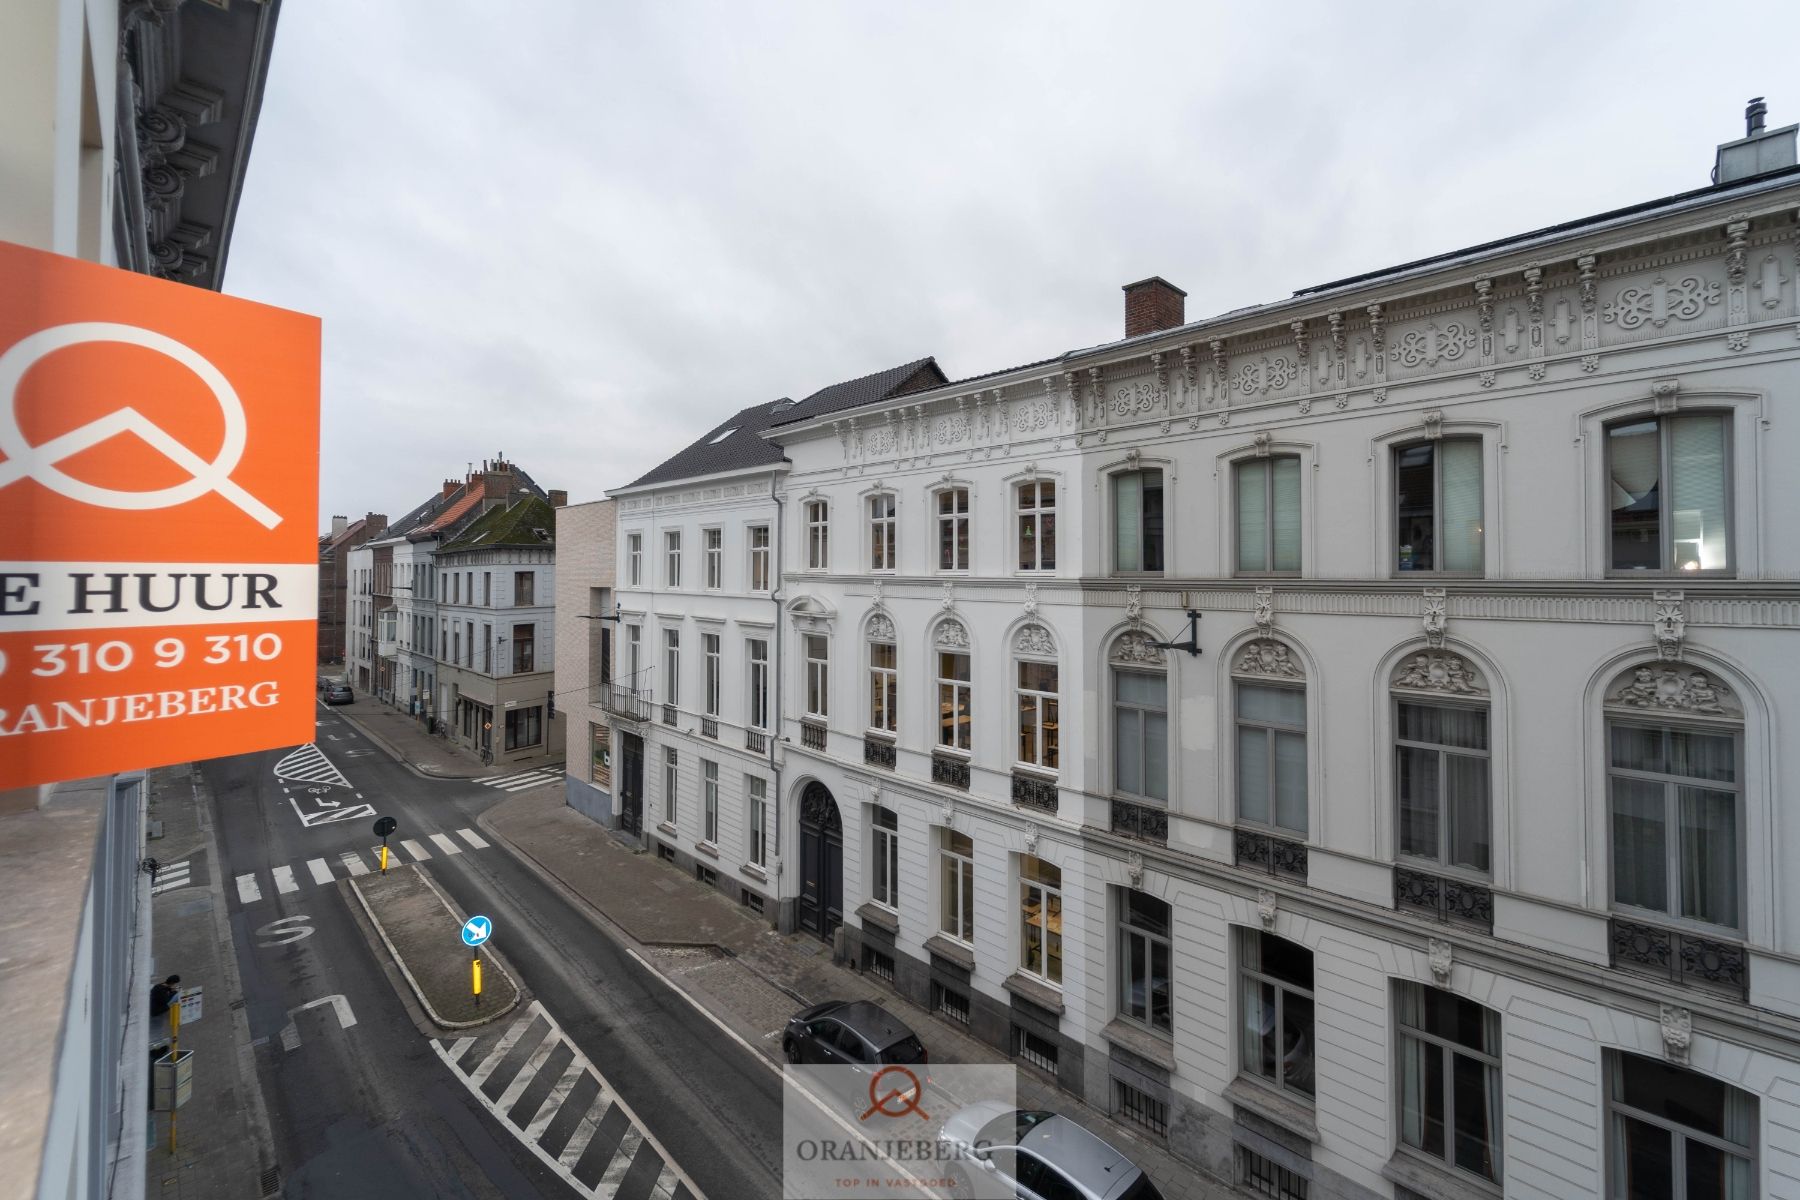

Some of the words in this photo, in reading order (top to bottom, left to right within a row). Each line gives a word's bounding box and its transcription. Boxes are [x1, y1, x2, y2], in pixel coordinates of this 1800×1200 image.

[67, 573, 283, 615] HUUR
[31, 640, 134, 677] 310
[154, 637, 185, 668] 9
[203, 632, 283, 665] 310
